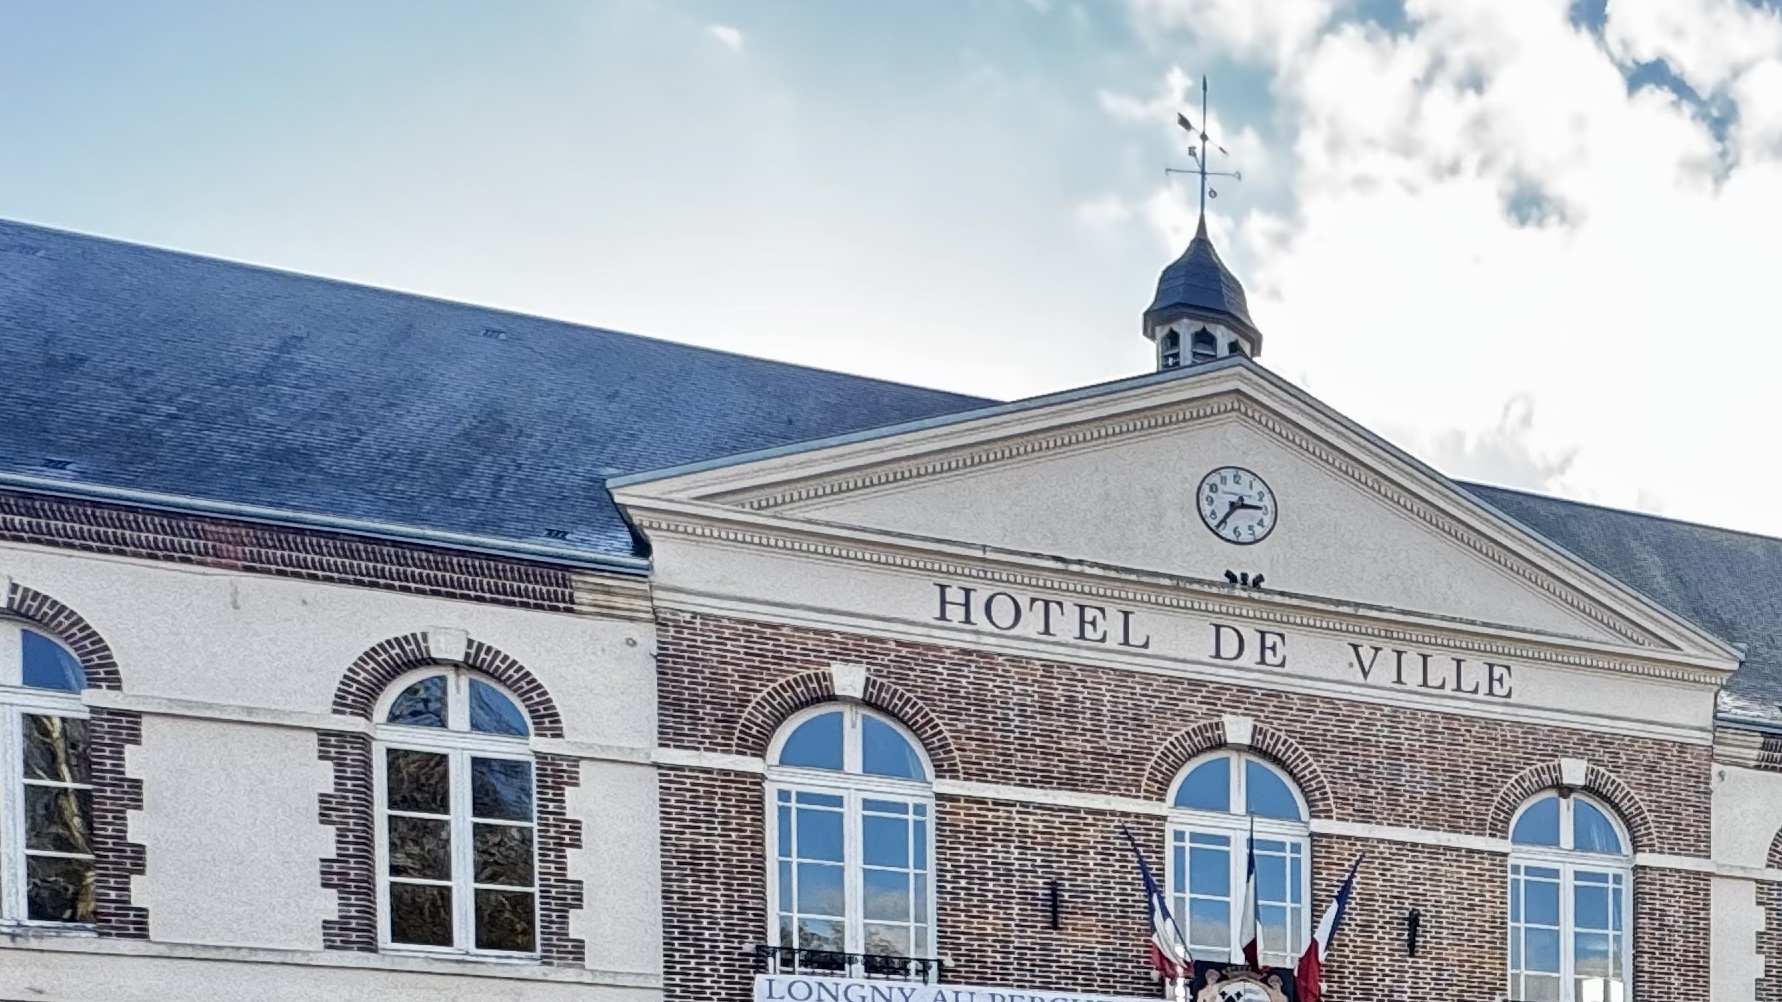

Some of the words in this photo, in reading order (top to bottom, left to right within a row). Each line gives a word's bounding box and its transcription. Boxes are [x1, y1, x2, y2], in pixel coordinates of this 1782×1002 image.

[933, 582, 1150, 650] HOTEL
[1208, 622, 1287, 669] DE
[1347, 643, 1514, 700] VILLE
